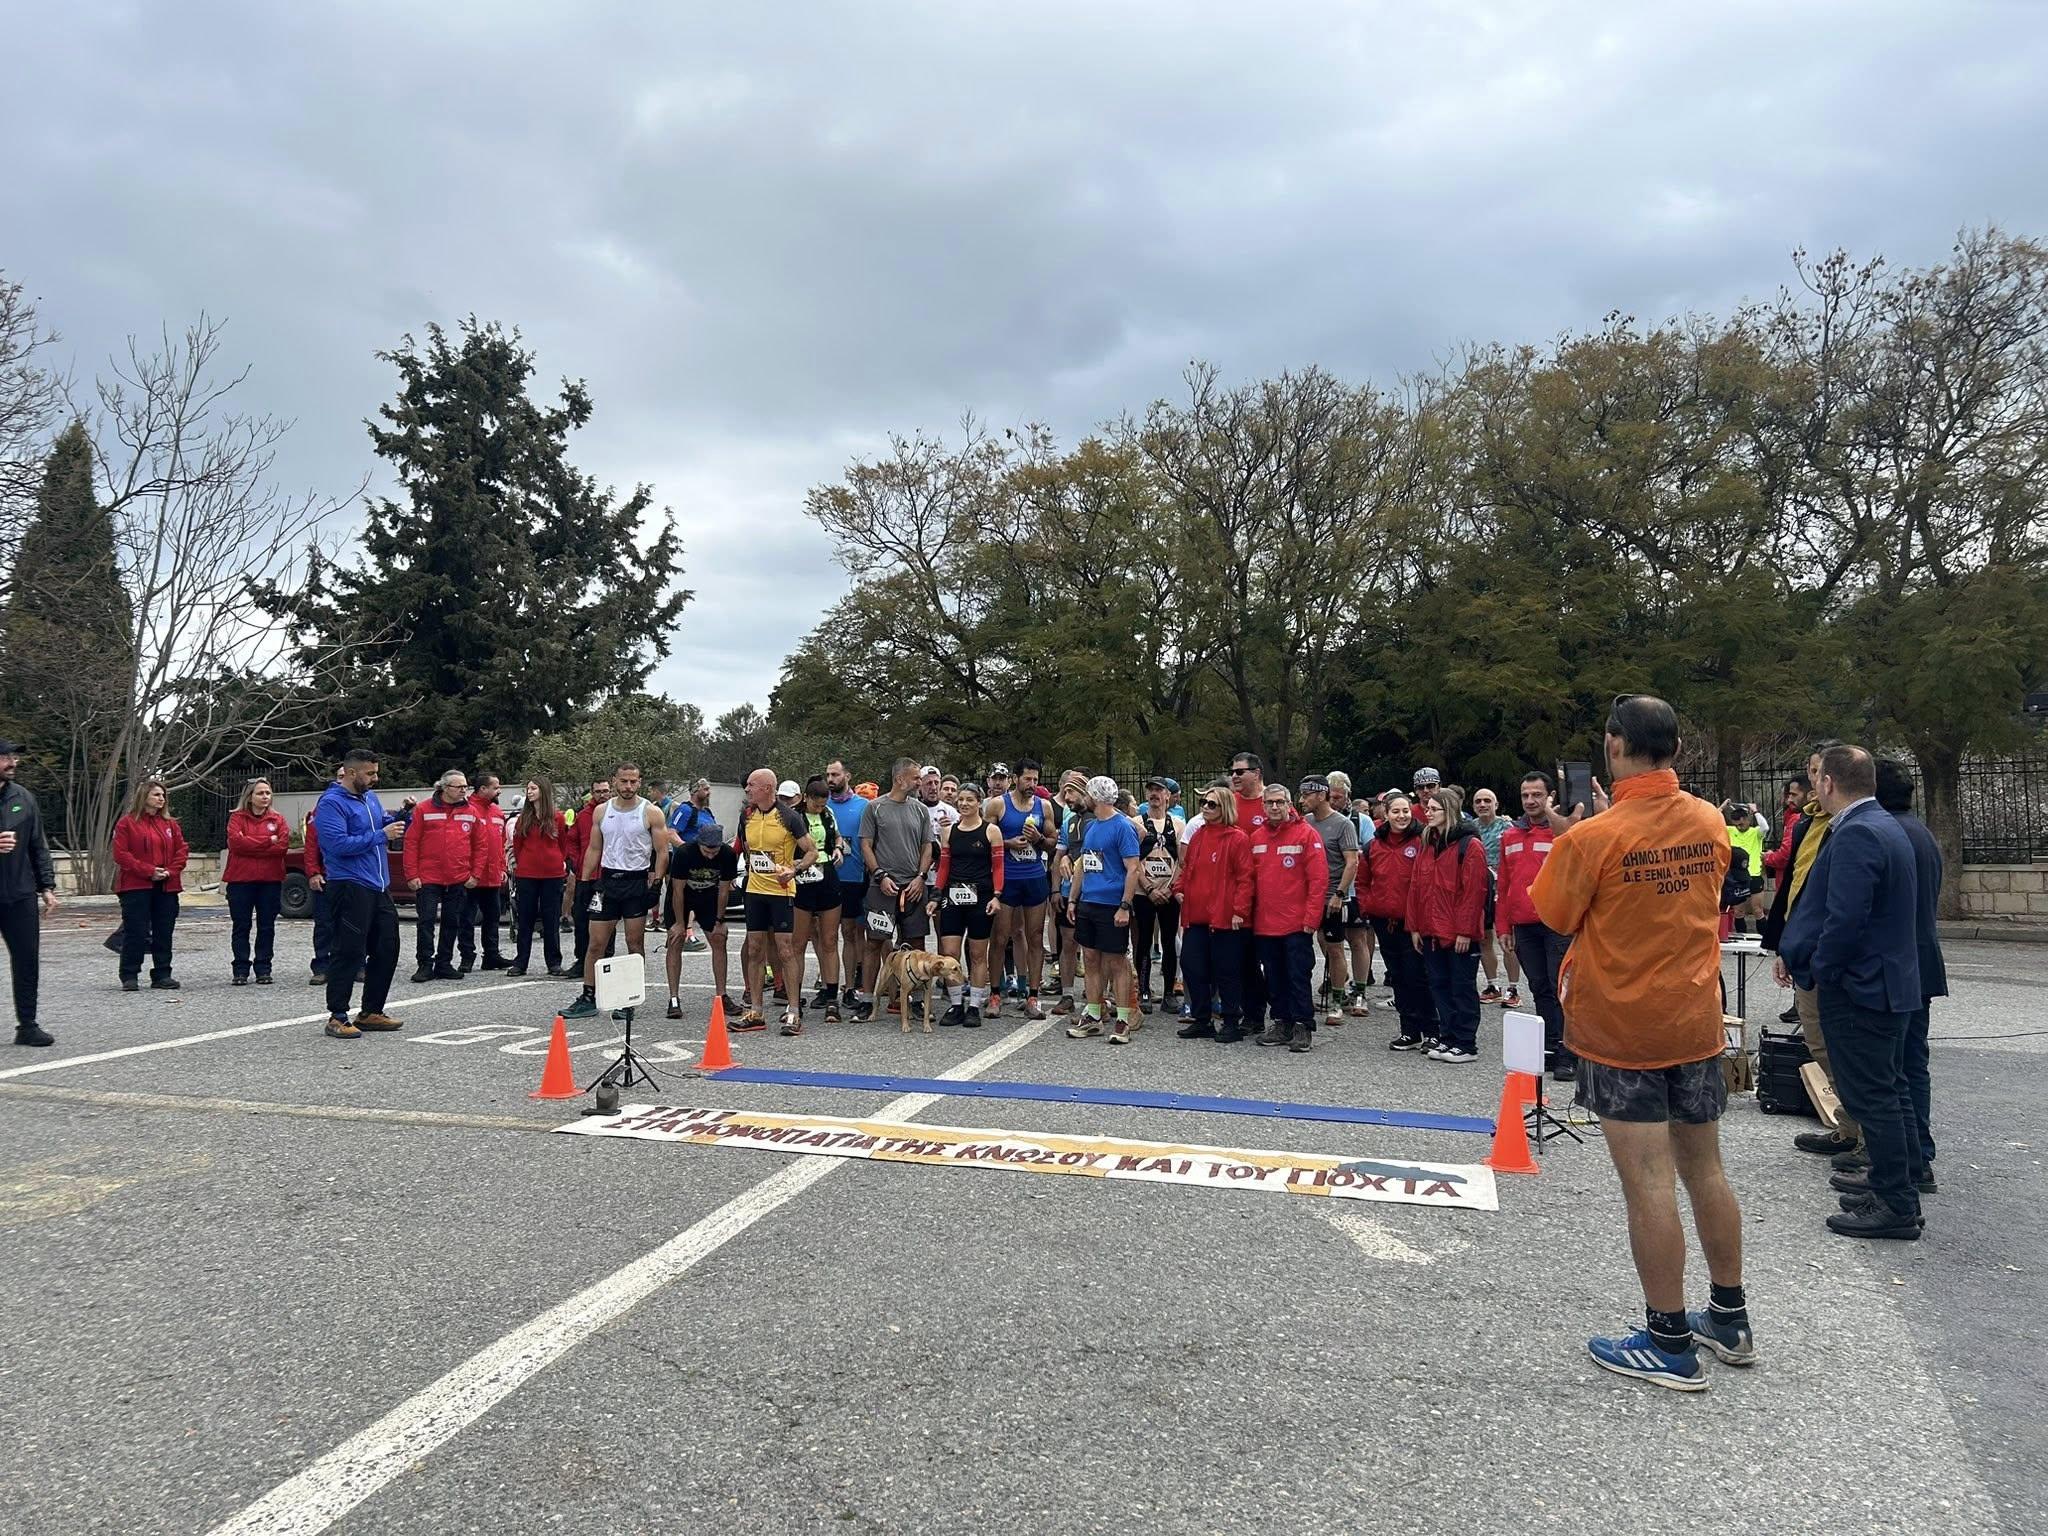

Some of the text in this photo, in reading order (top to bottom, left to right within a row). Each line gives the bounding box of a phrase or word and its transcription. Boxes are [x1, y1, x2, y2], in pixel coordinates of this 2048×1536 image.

[1623, 842, 1715, 867] ΔΗΜΟΣ ΤΥΜΠΑΚΙΟΥ
[1645, 867, 1672, 881] ΞΕΝΙΑ
[1679, 861, 1715, 876] ΦΑΙΣΤΟΣ
[955, 892, 971, 900] 0123
[1657, 880, 1689, 894] 2009
[601, 1117, 680, 1132] ΣΤΑ
[677, 1124, 880, 1149] ΜΟΝΟΠΑΤΙΑ
[876, 1138, 957, 1156] ΤΗΣ
[955, 1143, 1107, 1168] ΚΝΩΣΟΥ
[1114, 1154, 1192, 1173] ΚΑΙ
[1206, 1162, 1280, 1180] ΤΟΥ
